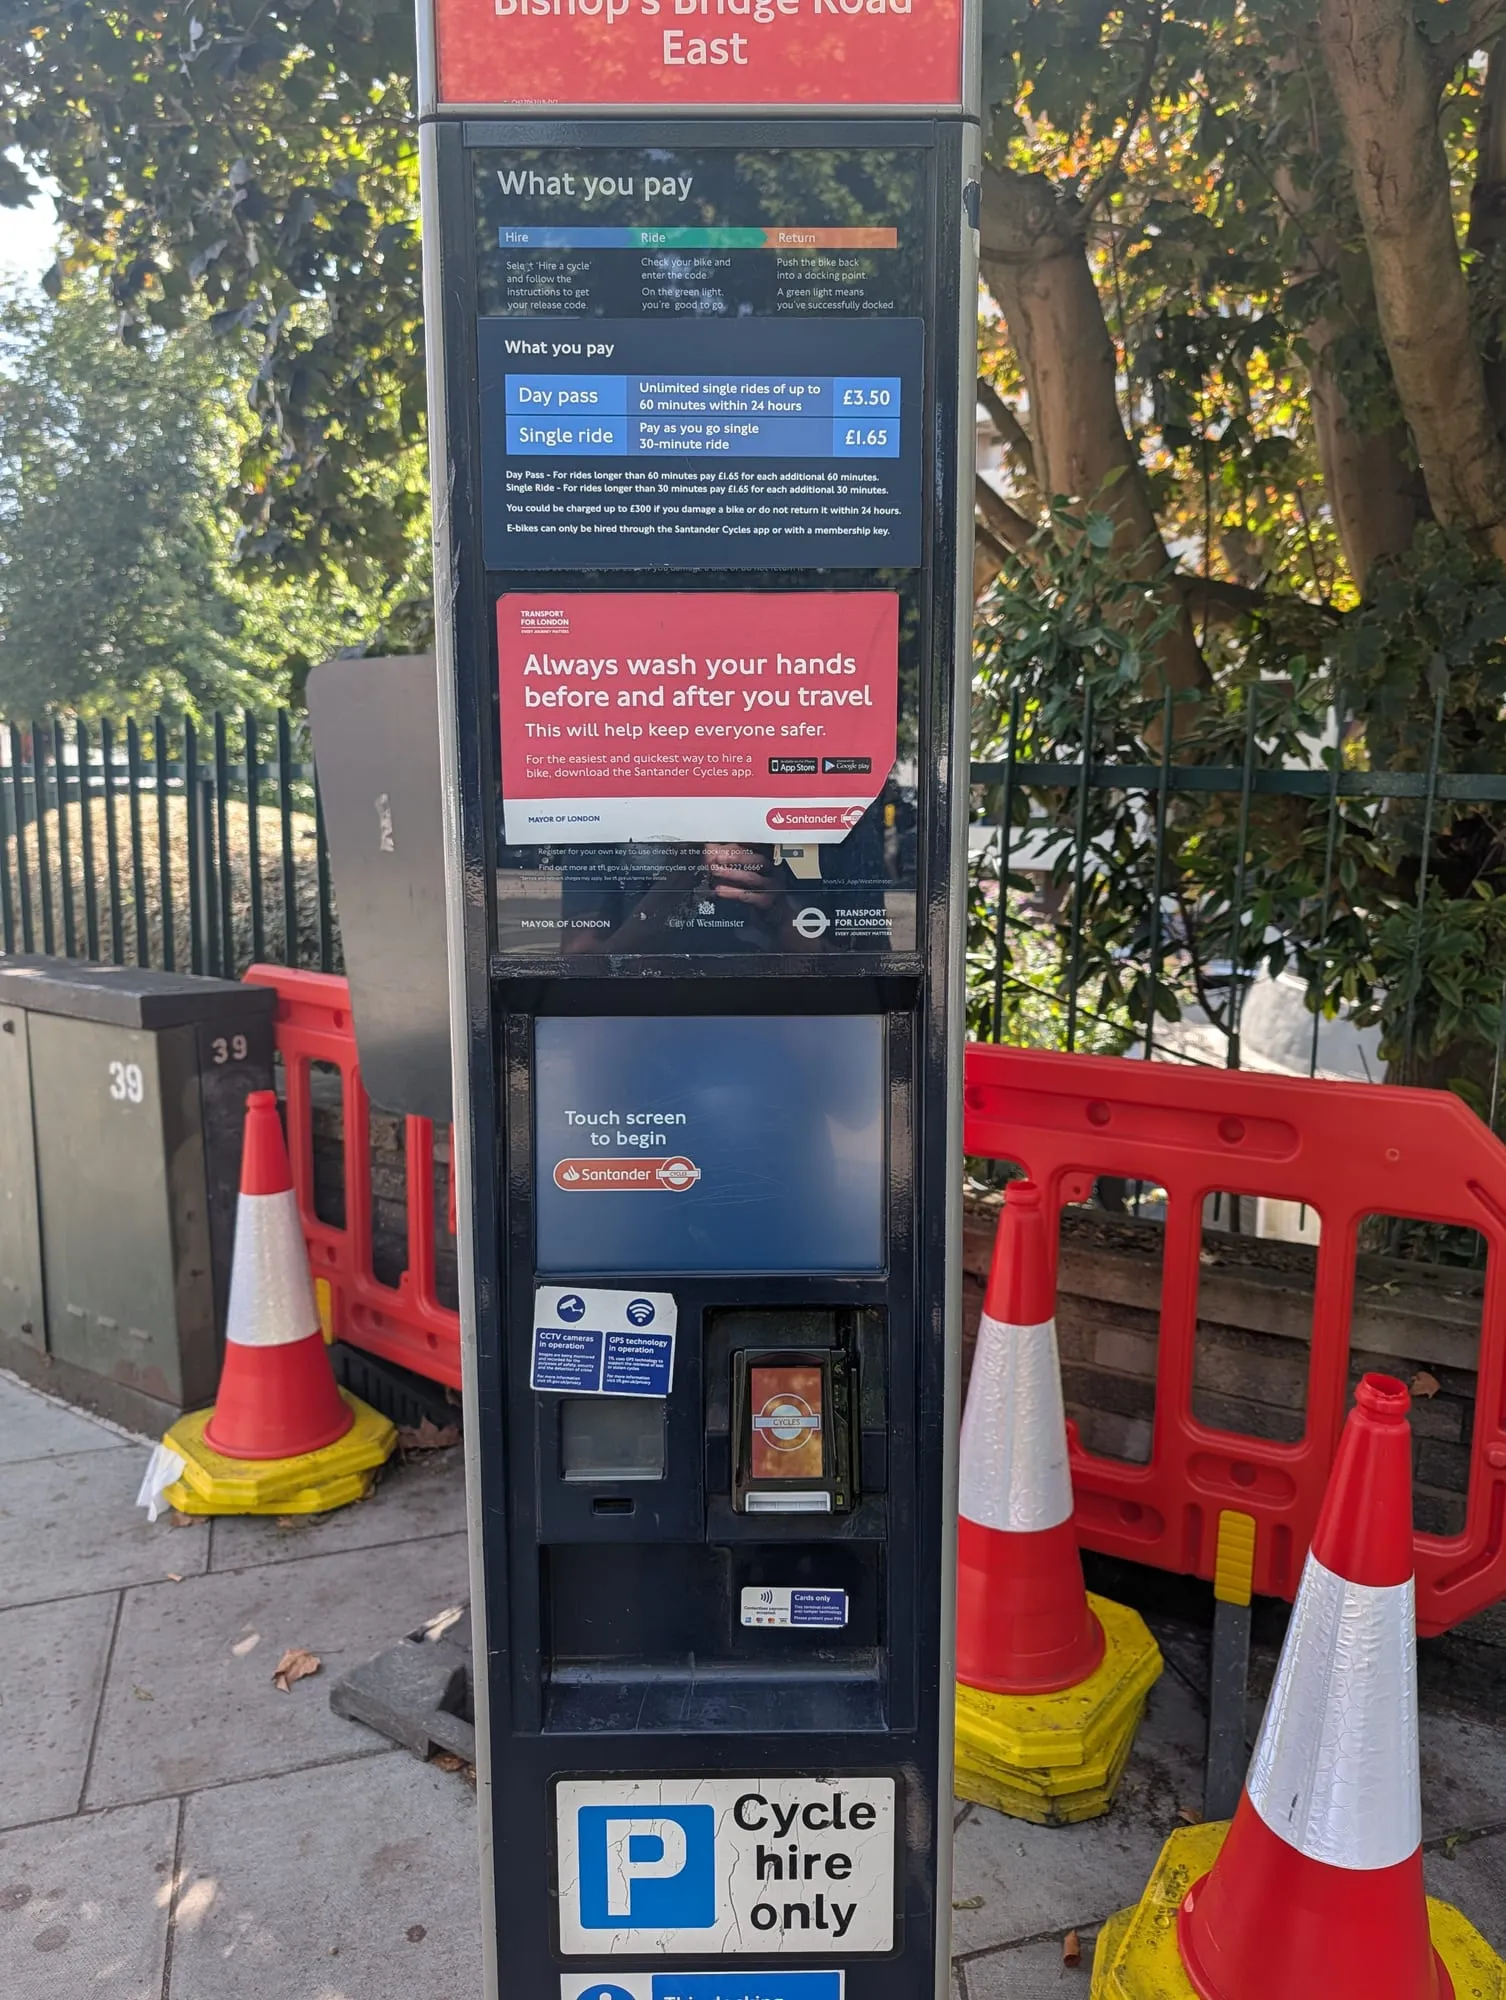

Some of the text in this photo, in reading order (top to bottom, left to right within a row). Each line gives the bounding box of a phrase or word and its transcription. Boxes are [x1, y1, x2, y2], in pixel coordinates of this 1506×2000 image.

[663, 30, 748, 64] East
[497, 170, 692, 201] What you pay
[505, 231, 528, 242] Hire
[641, 232, 665, 243] Ride
[778, 232, 815, 242] Return
[777, 257, 858, 269] Push the bike back
[777, 271, 795, 279] into
[804, 269, 839, 281] docking
[777, 287, 783, 296] A
[786, 289, 810, 297] green
[813, 287, 832, 298] light
[777, 300, 805, 311] you've
[807, 300, 860, 311] successfully
[504, 340, 614, 357] What you pay
[639, 382, 820, 396] Unlimited single rides of up to
[519, 387, 597, 406] Day pass
[843, 389, 889, 405] £3.50
[639, 399, 801, 411] 60 minutes within 24 hours
[640, 422, 758, 436] Pay as you go single
[519, 427, 612, 446] Single ride
[845, 429, 886, 445] £1.65
[639, 438, 729, 449] 30-minute ride
[506, 470, 522, 480] Day
[525, 470, 544, 478] Pass
[552, 470, 567, 479] For
[569, 471, 592, 479] rides
[594, 471, 622, 481] longer
[624, 471, 645, 479] than
[647, 471, 658, 479] 60
[661, 471, 697, 480] minutes
[700, 473, 715, 481] pay
[718, 471, 738, 480] £1.65
[741, 472, 754, 480] for
[756, 472, 777, 480] each
[780, 472, 824, 480] additional
[827, 472, 838, 480] 60
[840, 473, 879, 481] minutes.
[506, 523, 538, 532] E-bikes
[558, 524, 578, 534] only
[580, 524, 591, 532] be
[594, 524, 616, 532] hired
[619, 524, 654, 534] through
[657, 524, 672, 533] the
[674, 524, 720, 533] Santander
[721, 525, 750, 535] Cycles
[753, 527, 769, 535] app
[784, 526, 804, 534] with
[814, 526, 870, 536] membership
[873, 526, 889, 536] key.
[524, 652, 855, 680] Always wash your hands
[525, 684, 872, 711] before and after you travel
[525, 721, 825, 739] This will help keep everyone safer.
[526, 754, 543, 764] For
[547, 754, 565, 763] the
[568, 754, 607, 763] easiest
[610, 753, 630, 763] and
[633, 753, 679, 764] quickest
[682, 755, 704, 764] way
[707, 754, 719, 763] to
[722, 752, 743, 762] hire
[526, 766, 753, 778] bike, download the Santander Cycles app.
[780, 763, 795, 772] App
[786, 814, 837, 823] Santander
[668, 918, 744, 928] City of Westminster
[211, 1034, 248, 1064] 39
[109, 1061, 144, 1103] 39
[565, 1110, 685, 1124] Touch screen
[590, 1130, 666, 1148] to begin
[582, 1168, 650, 1180] Santander
[540, 1332, 562, 1340] CCTV
[626, 1338, 668, 1348] technology
[618, 1346, 654, 1354] operation
[733, 1793, 877, 1838] Cycle
[606, 1818, 686, 1916] P
[756, 1844, 852, 1880] hire
[750, 1894, 858, 1938] only
